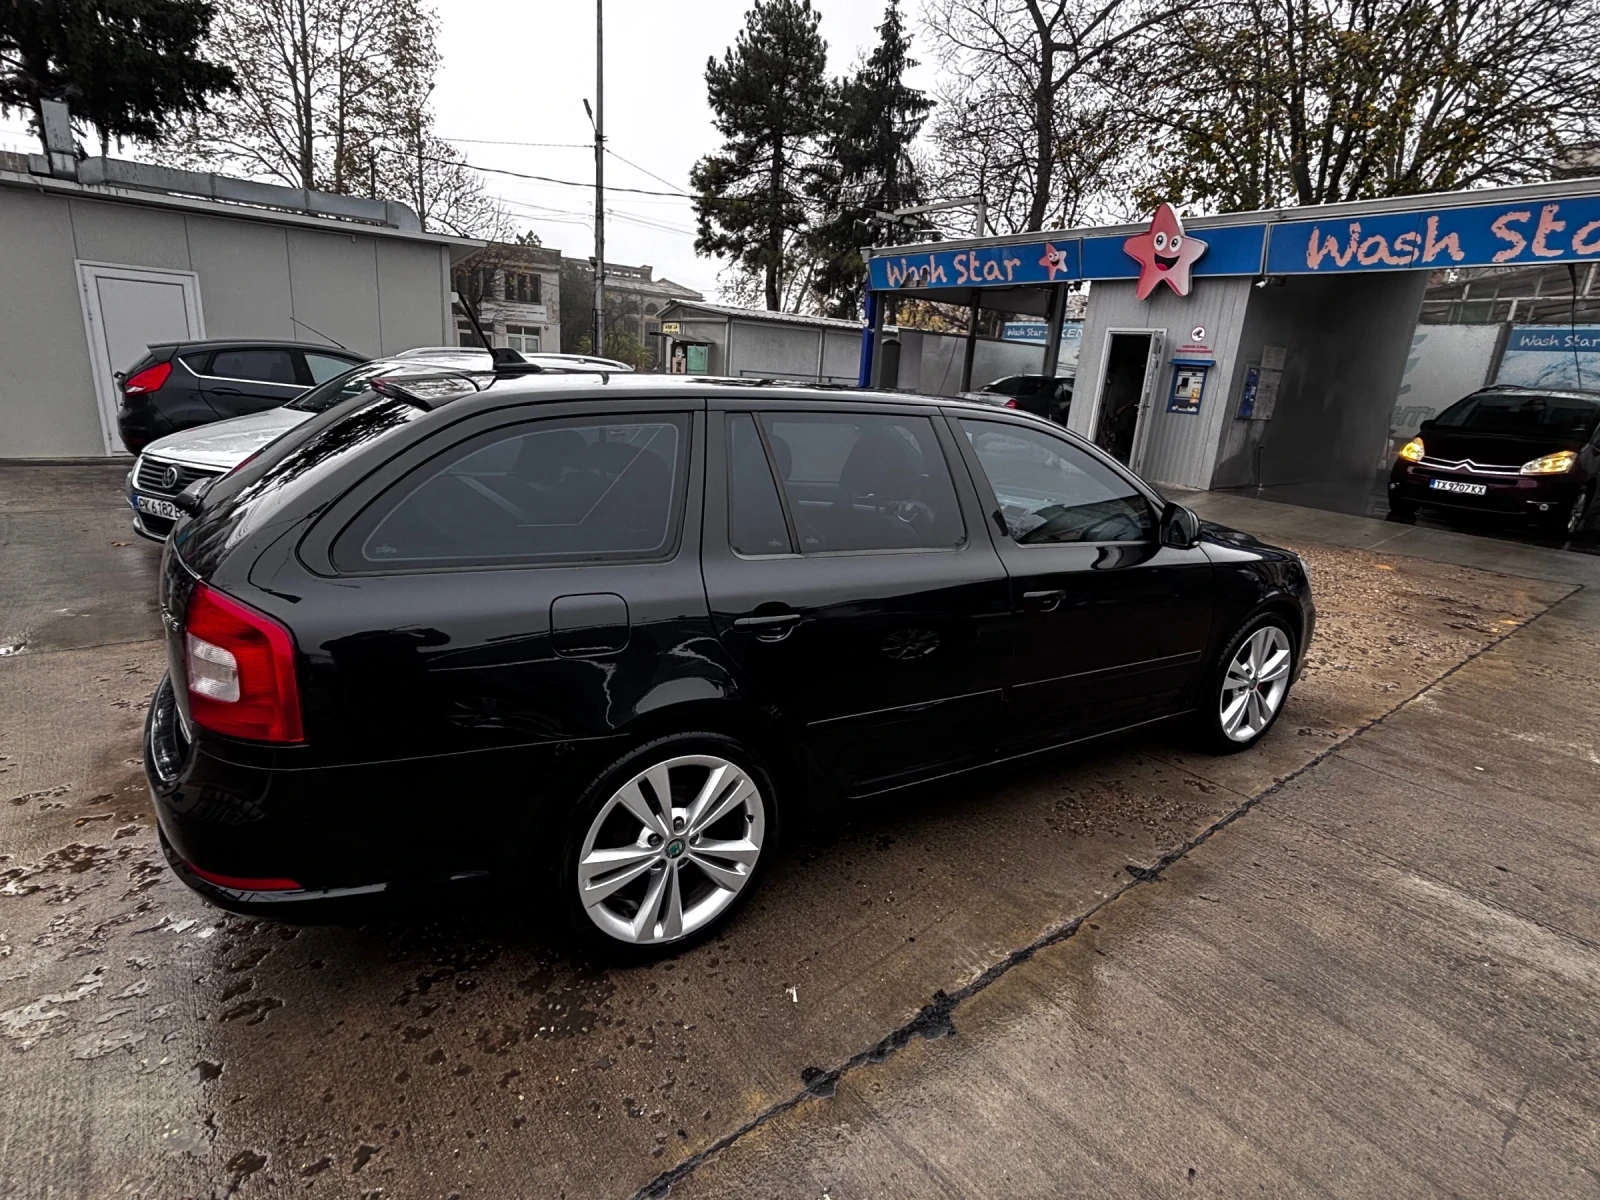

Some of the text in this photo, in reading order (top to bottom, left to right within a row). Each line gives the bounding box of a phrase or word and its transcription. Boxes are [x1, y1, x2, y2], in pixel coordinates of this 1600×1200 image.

[1306, 215, 1465, 270] Wash
[953, 251, 1021, 284] Star
[1007, 327, 1043, 337] Wash Star
[1520, 334, 1600, 347] Wash Star
[1448, 482, 1471, 492] 9707
[1471, 485, 1485, 494] KX
[151, 502, 174, 518] 6182
